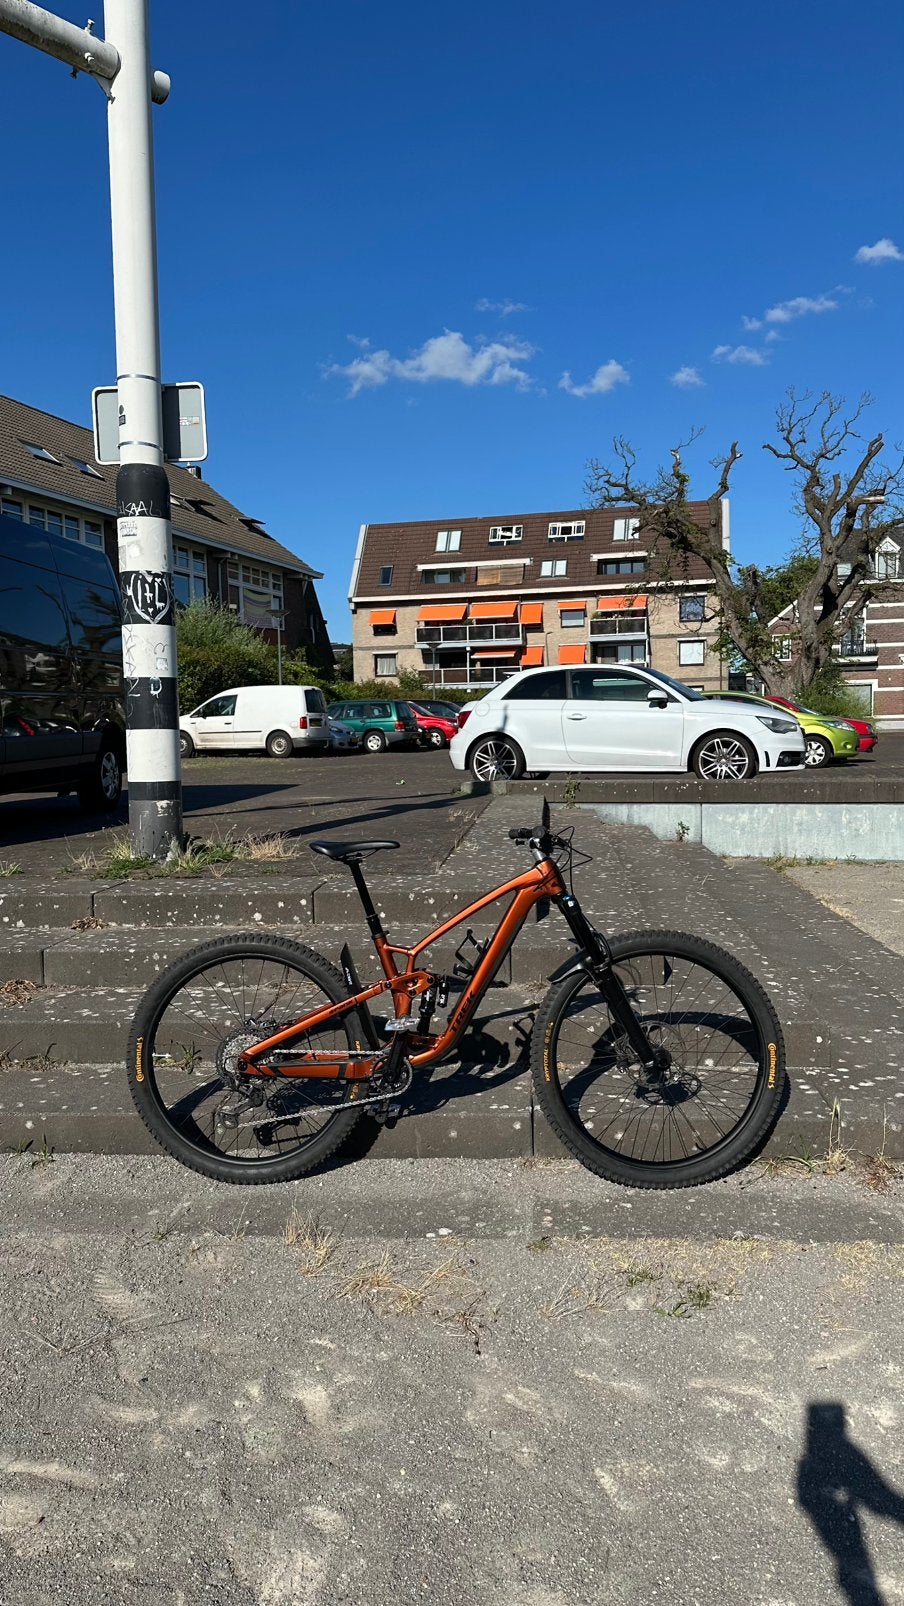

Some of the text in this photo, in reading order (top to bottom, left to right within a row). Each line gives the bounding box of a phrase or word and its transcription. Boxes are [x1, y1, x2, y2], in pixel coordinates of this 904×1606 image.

[449, 990, 476, 1032] TREK
[135, 1042, 145, 1082] Continental
[767, 1042, 777, 1083] Continental
